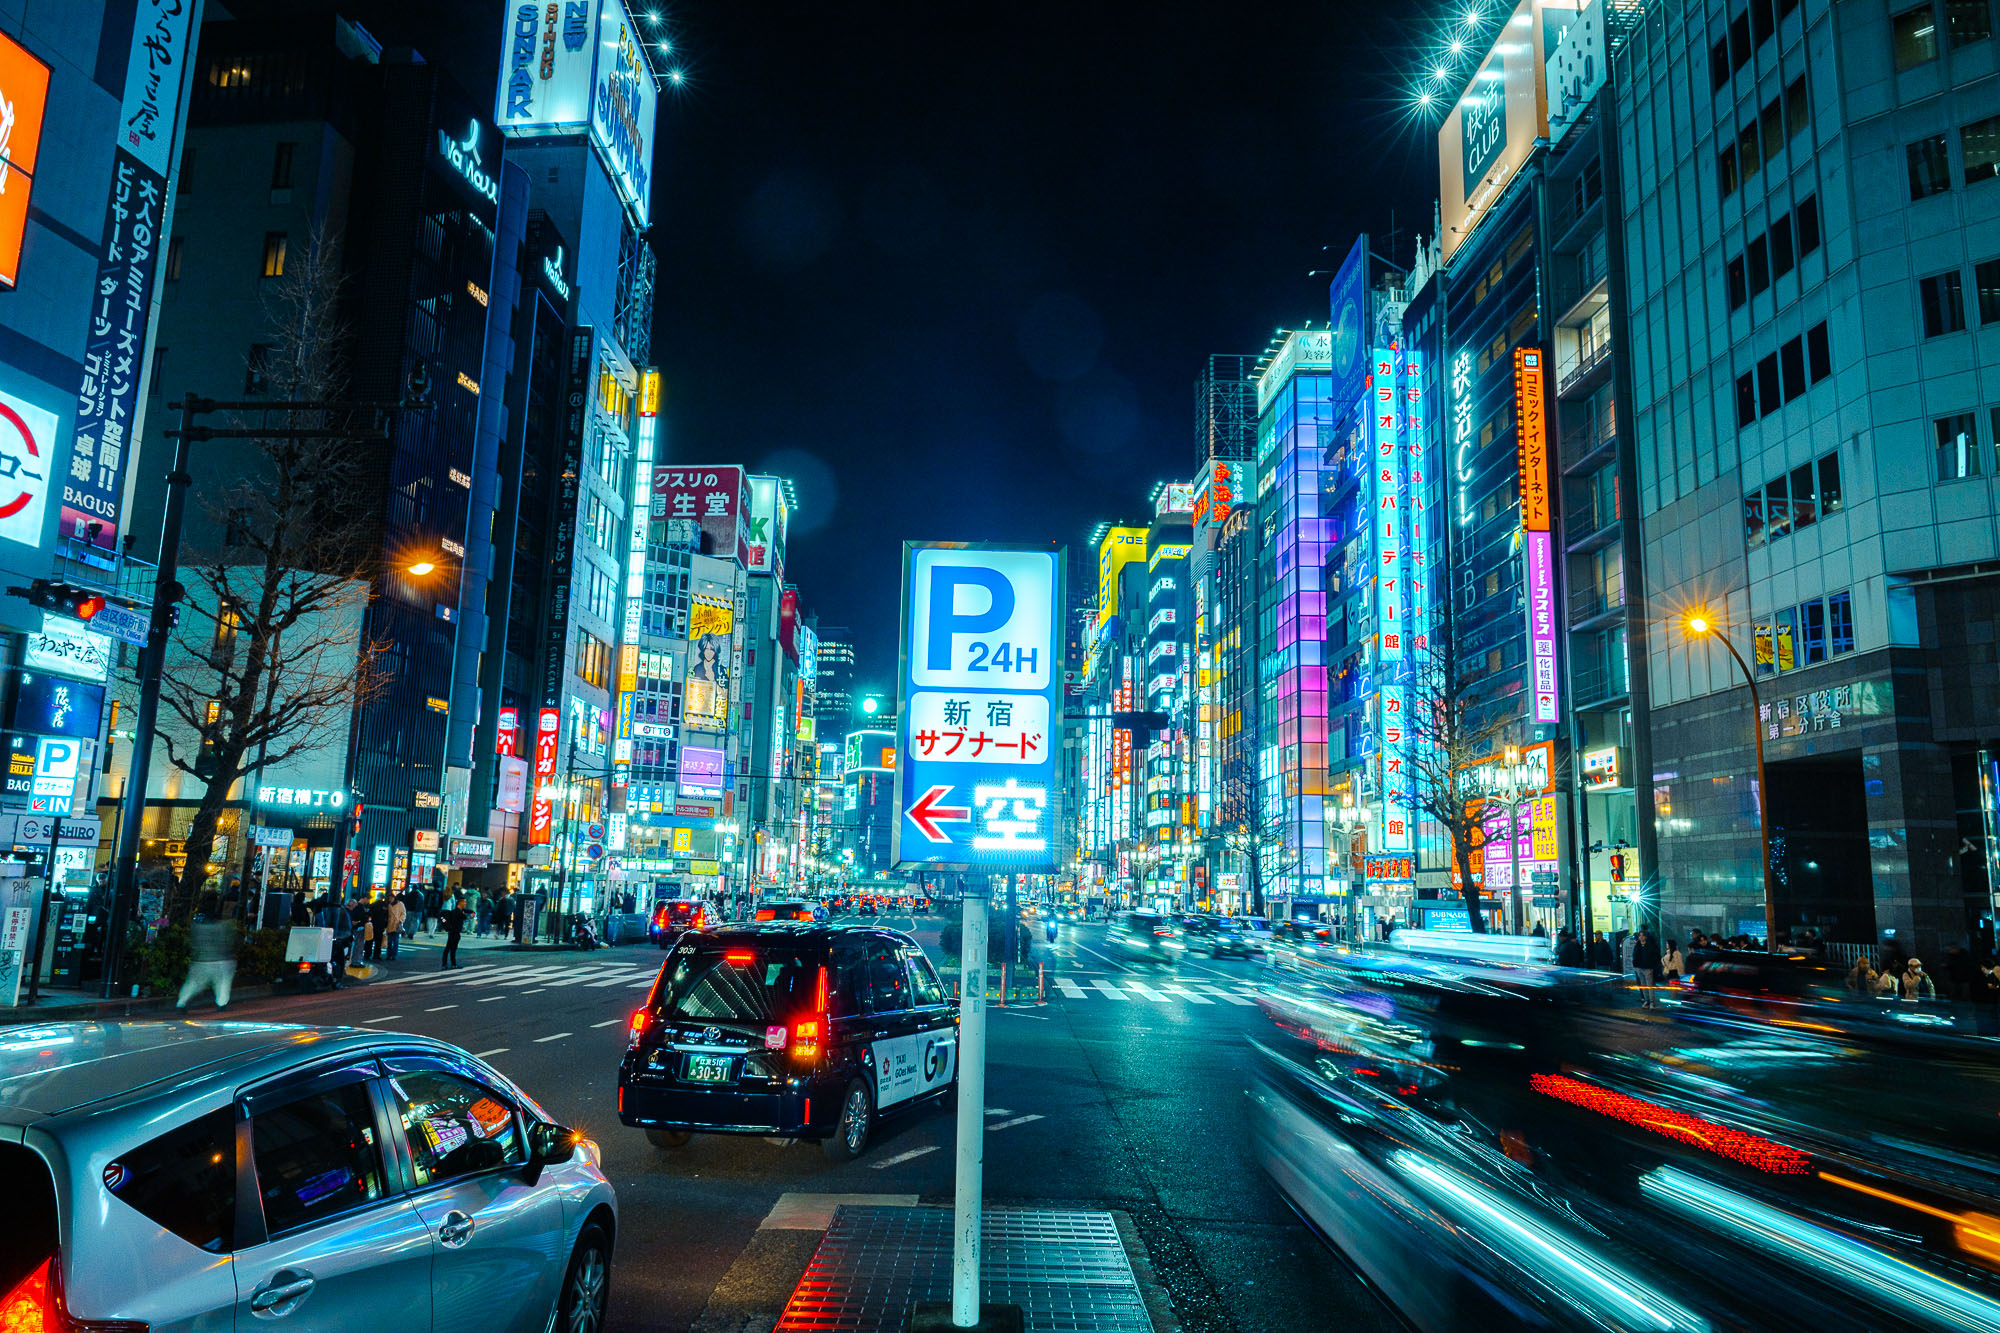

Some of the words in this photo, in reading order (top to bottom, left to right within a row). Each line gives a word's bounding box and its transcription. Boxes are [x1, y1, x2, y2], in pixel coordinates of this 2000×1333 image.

[563, 1, 588, 52] NEW
[540, 3, 559, 81] SHINJUKU
[506, 4, 539, 119] SUNPARK
[1468, 116, 1500, 175] CLUB
[1525, 373, 1544, 520] コミック・インターネット
[654, 473, 719, 488] クスリの
[62, 485, 115, 518] BAGUS
[96, 607, 148, 633] 宿区役所前
[927, 565, 1016, 671] P
[1534, 587, 1550, 636] コスモス
[967, 641, 1038, 674] 24H
[1539, 658, 1552, 691] 化粧品
[943, 699, 1014, 727] 新宿
[1759, 685, 1851, 723] 新宿区役所
[1768, 711, 1842, 740] 第一分庁舎
[42, 743, 71, 773] P
[915, 726, 1042, 760] サブナード
[36, 782, 72, 791] サブナード
[259, 786, 329, 806] 新宿横丁
[427, 795, 440, 807] PUB
[49, 797, 70, 813] IN
[973, 778, 1047, 851] 空
[1537, 825, 1554, 841] TAX
[1536, 843, 1555, 856] FREE
[1366, 857, 1411, 879] カラオケ館
[677, 946, 697, 955] 3031
[696, 1065, 728, 1081] 30-31
